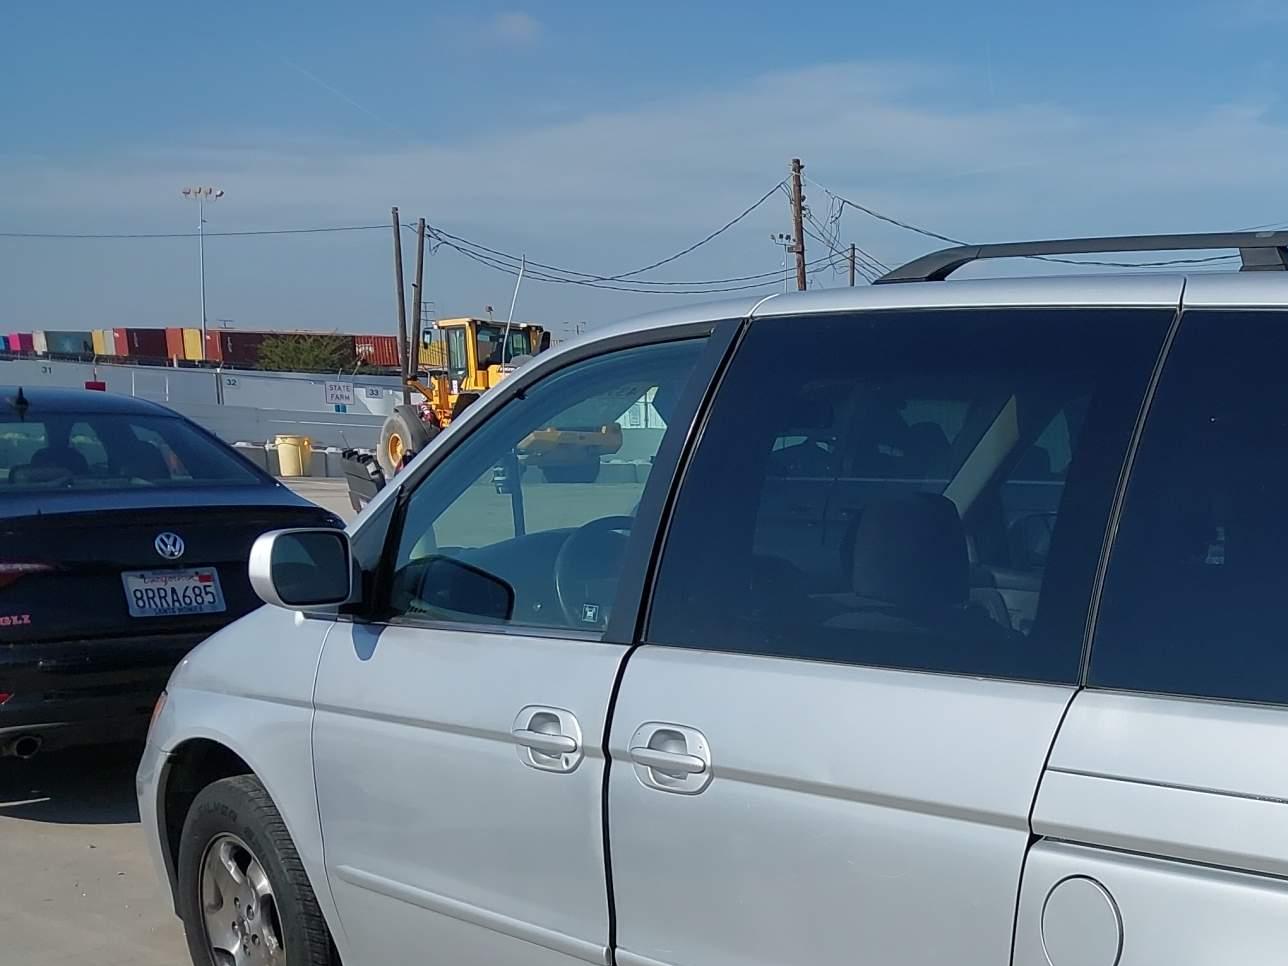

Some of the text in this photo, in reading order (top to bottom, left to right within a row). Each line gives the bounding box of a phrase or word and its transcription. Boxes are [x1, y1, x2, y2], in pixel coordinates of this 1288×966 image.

[41, 366, 52, 374] 31
[329, 384, 350, 392] STATE
[368, 388, 379, 396] 33
[330, 393, 350, 401] FARM
[133, 584, 217, 609] 8RRA685
